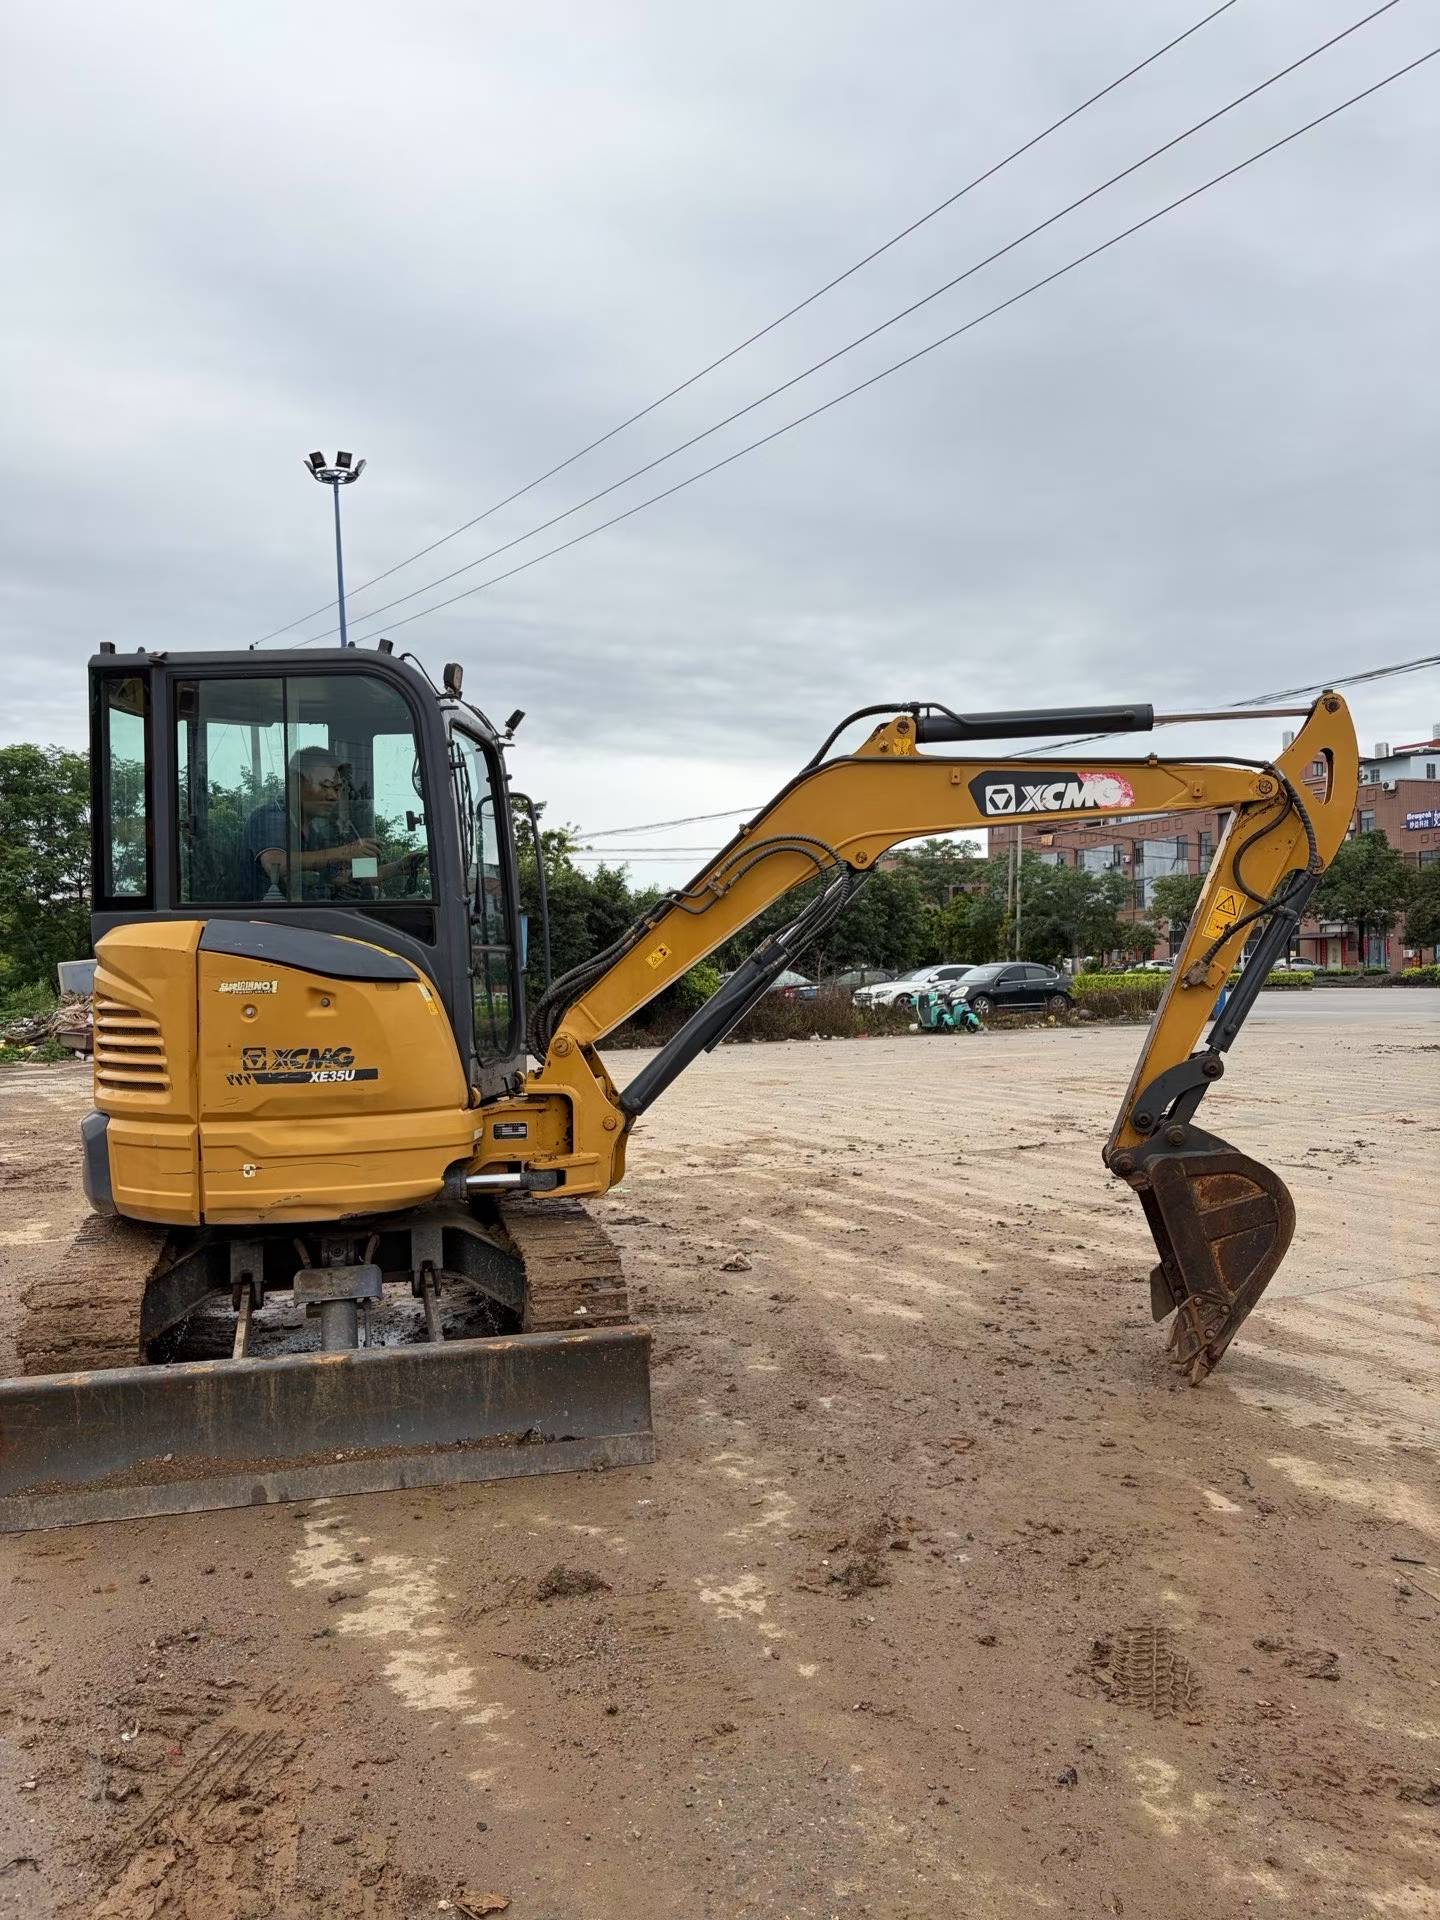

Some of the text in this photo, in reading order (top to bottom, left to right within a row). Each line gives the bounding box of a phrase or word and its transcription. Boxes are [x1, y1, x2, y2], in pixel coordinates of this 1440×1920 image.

[1016, 778, 1121, 813] XCMG
[268, 1047, 355, 1071] XCMG
[309, 1070, 356, 1083] XE35U
